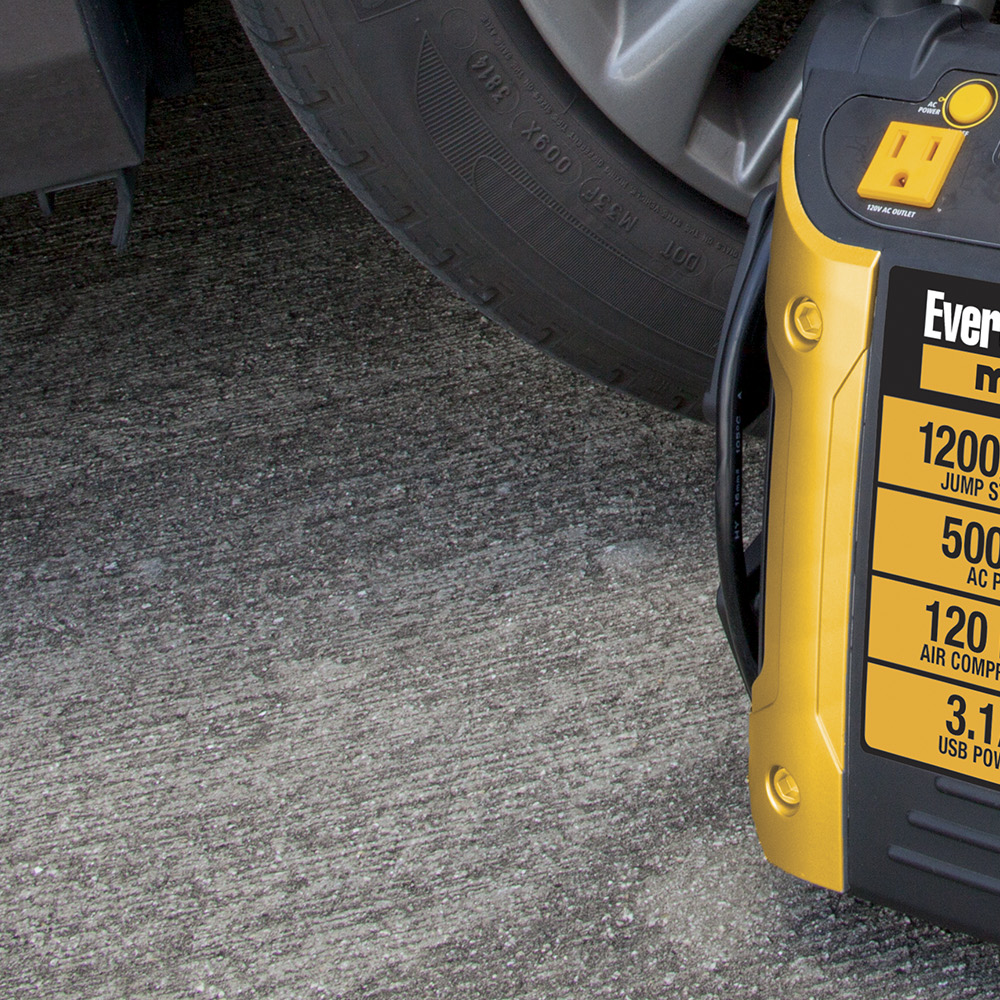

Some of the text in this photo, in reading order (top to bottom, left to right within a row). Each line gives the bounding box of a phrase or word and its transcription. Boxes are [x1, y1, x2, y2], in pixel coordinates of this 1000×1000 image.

[468, 53, 510, 104] 3814
[918, 107, 941, 115] POWER
[521, 120, 571, 175] 009X
[866, 204, 883, 212] 120V
[892, 208, 916, 218] OUTLET
[582, 188, 701, 273] DOT M33F
[940, 472, 984, 496] JUMP
[966, 565, 990, 588] AC
[925, 600, 987, 655] 120
[920, 644, 946, 667] AIR
[938, 736, 968, 759] USB
